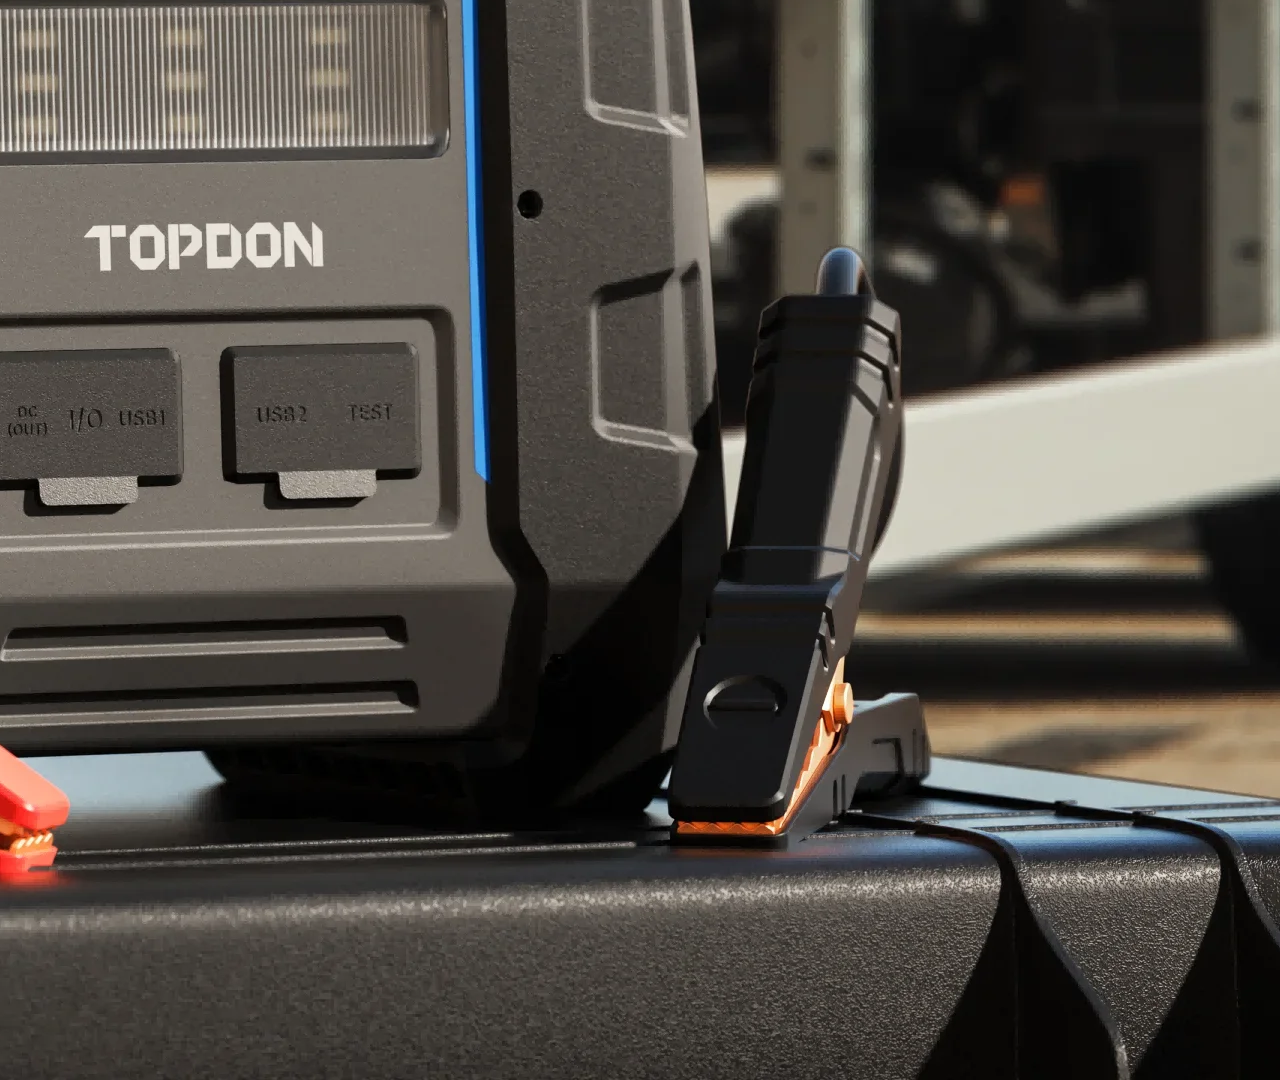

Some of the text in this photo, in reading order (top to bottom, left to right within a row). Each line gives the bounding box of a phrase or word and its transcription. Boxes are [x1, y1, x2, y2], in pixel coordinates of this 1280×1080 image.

[83, 221, 325, 271] TOPDON
[17, 405, 38, 418] DC
[119, 408, 167, 427] USB1
[256, 405, 308, 423] USB2
[347, 403, 394, 421] TEST
[7, 421, 49, 438] (OUT)
